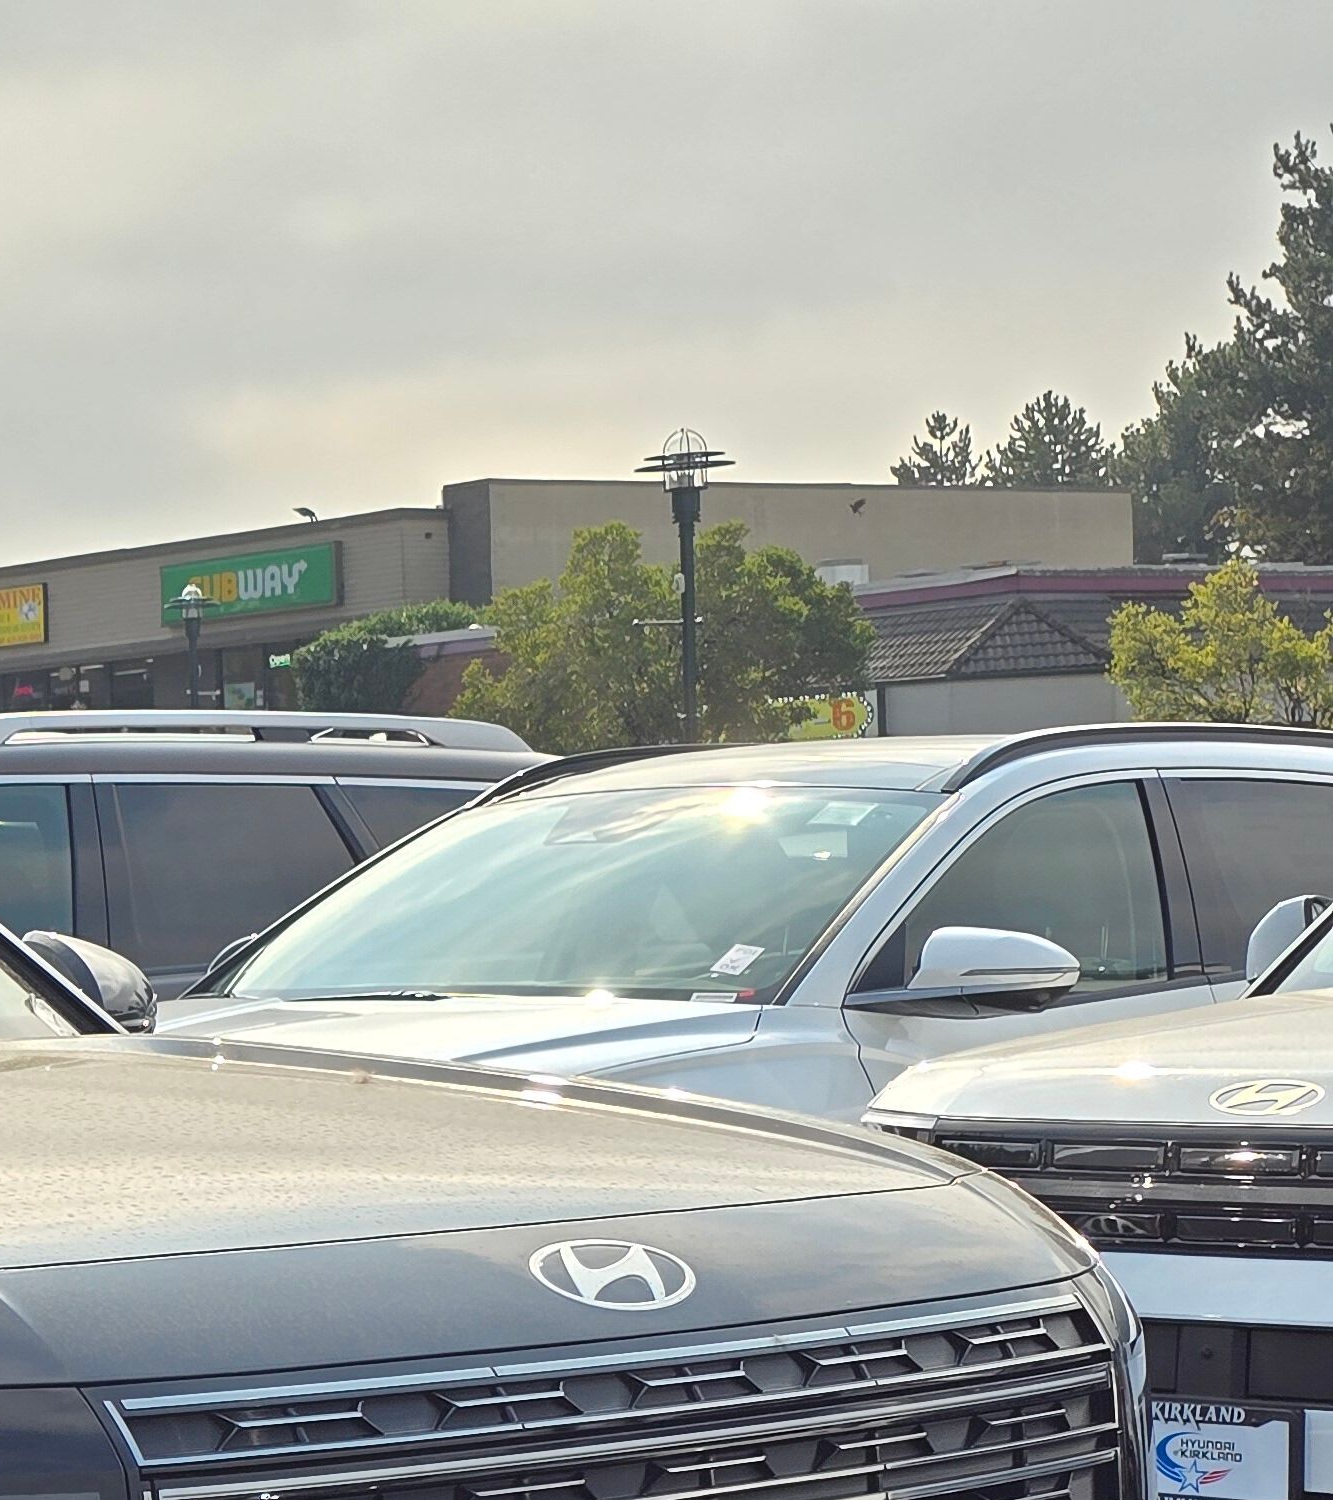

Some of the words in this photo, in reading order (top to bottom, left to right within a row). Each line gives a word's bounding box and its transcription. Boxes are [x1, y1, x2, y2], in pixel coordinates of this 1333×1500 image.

[1152, 1402, 1245, 1430] KIRKLAND
[1181, 1438, 1235, 1451] HYUNDAI
[1180, 1449, 1242, 1462] KIRKLAND
